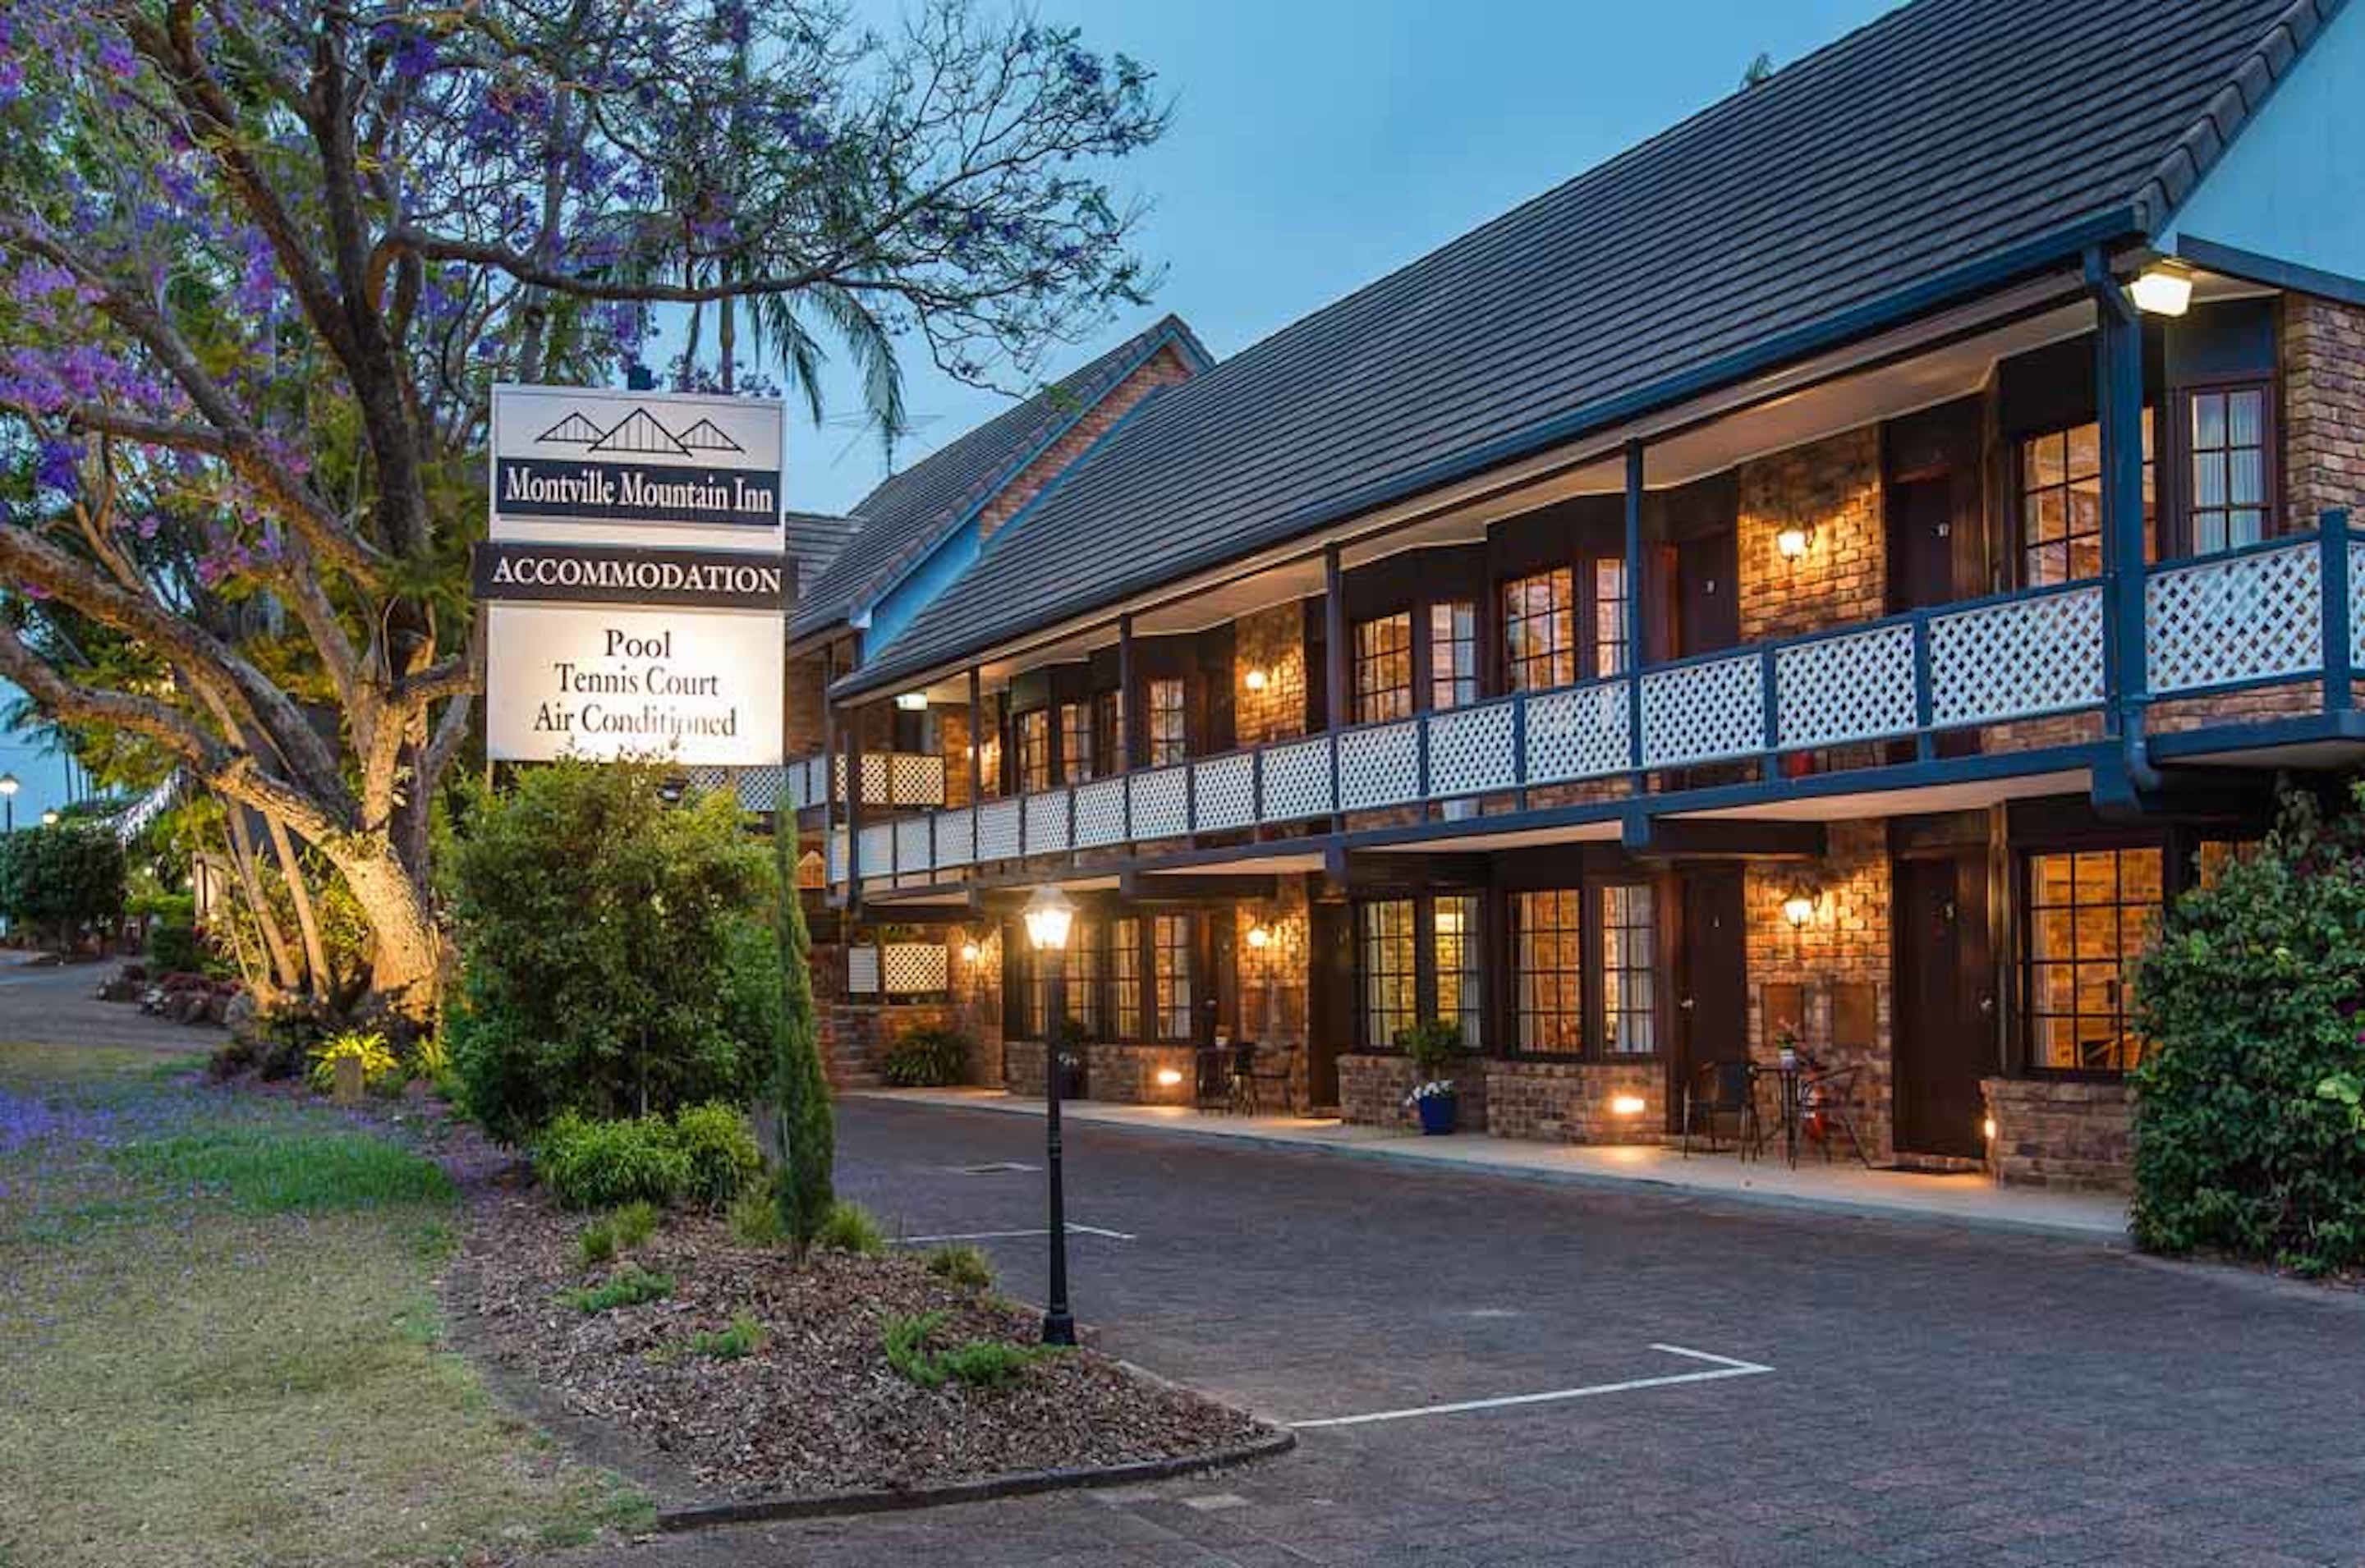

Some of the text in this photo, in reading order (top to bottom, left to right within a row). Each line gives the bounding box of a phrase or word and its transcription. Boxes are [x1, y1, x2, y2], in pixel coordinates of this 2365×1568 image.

[506, 465, 774, 513] Montville Mountain Inn
[493, 556, 783, 594] ACCOMMODATION
[604, 628, 672, 659] Pool
[553, 662, 719, 697] Tennis Court
[533, 701, 738, 738] Air Conditioned
